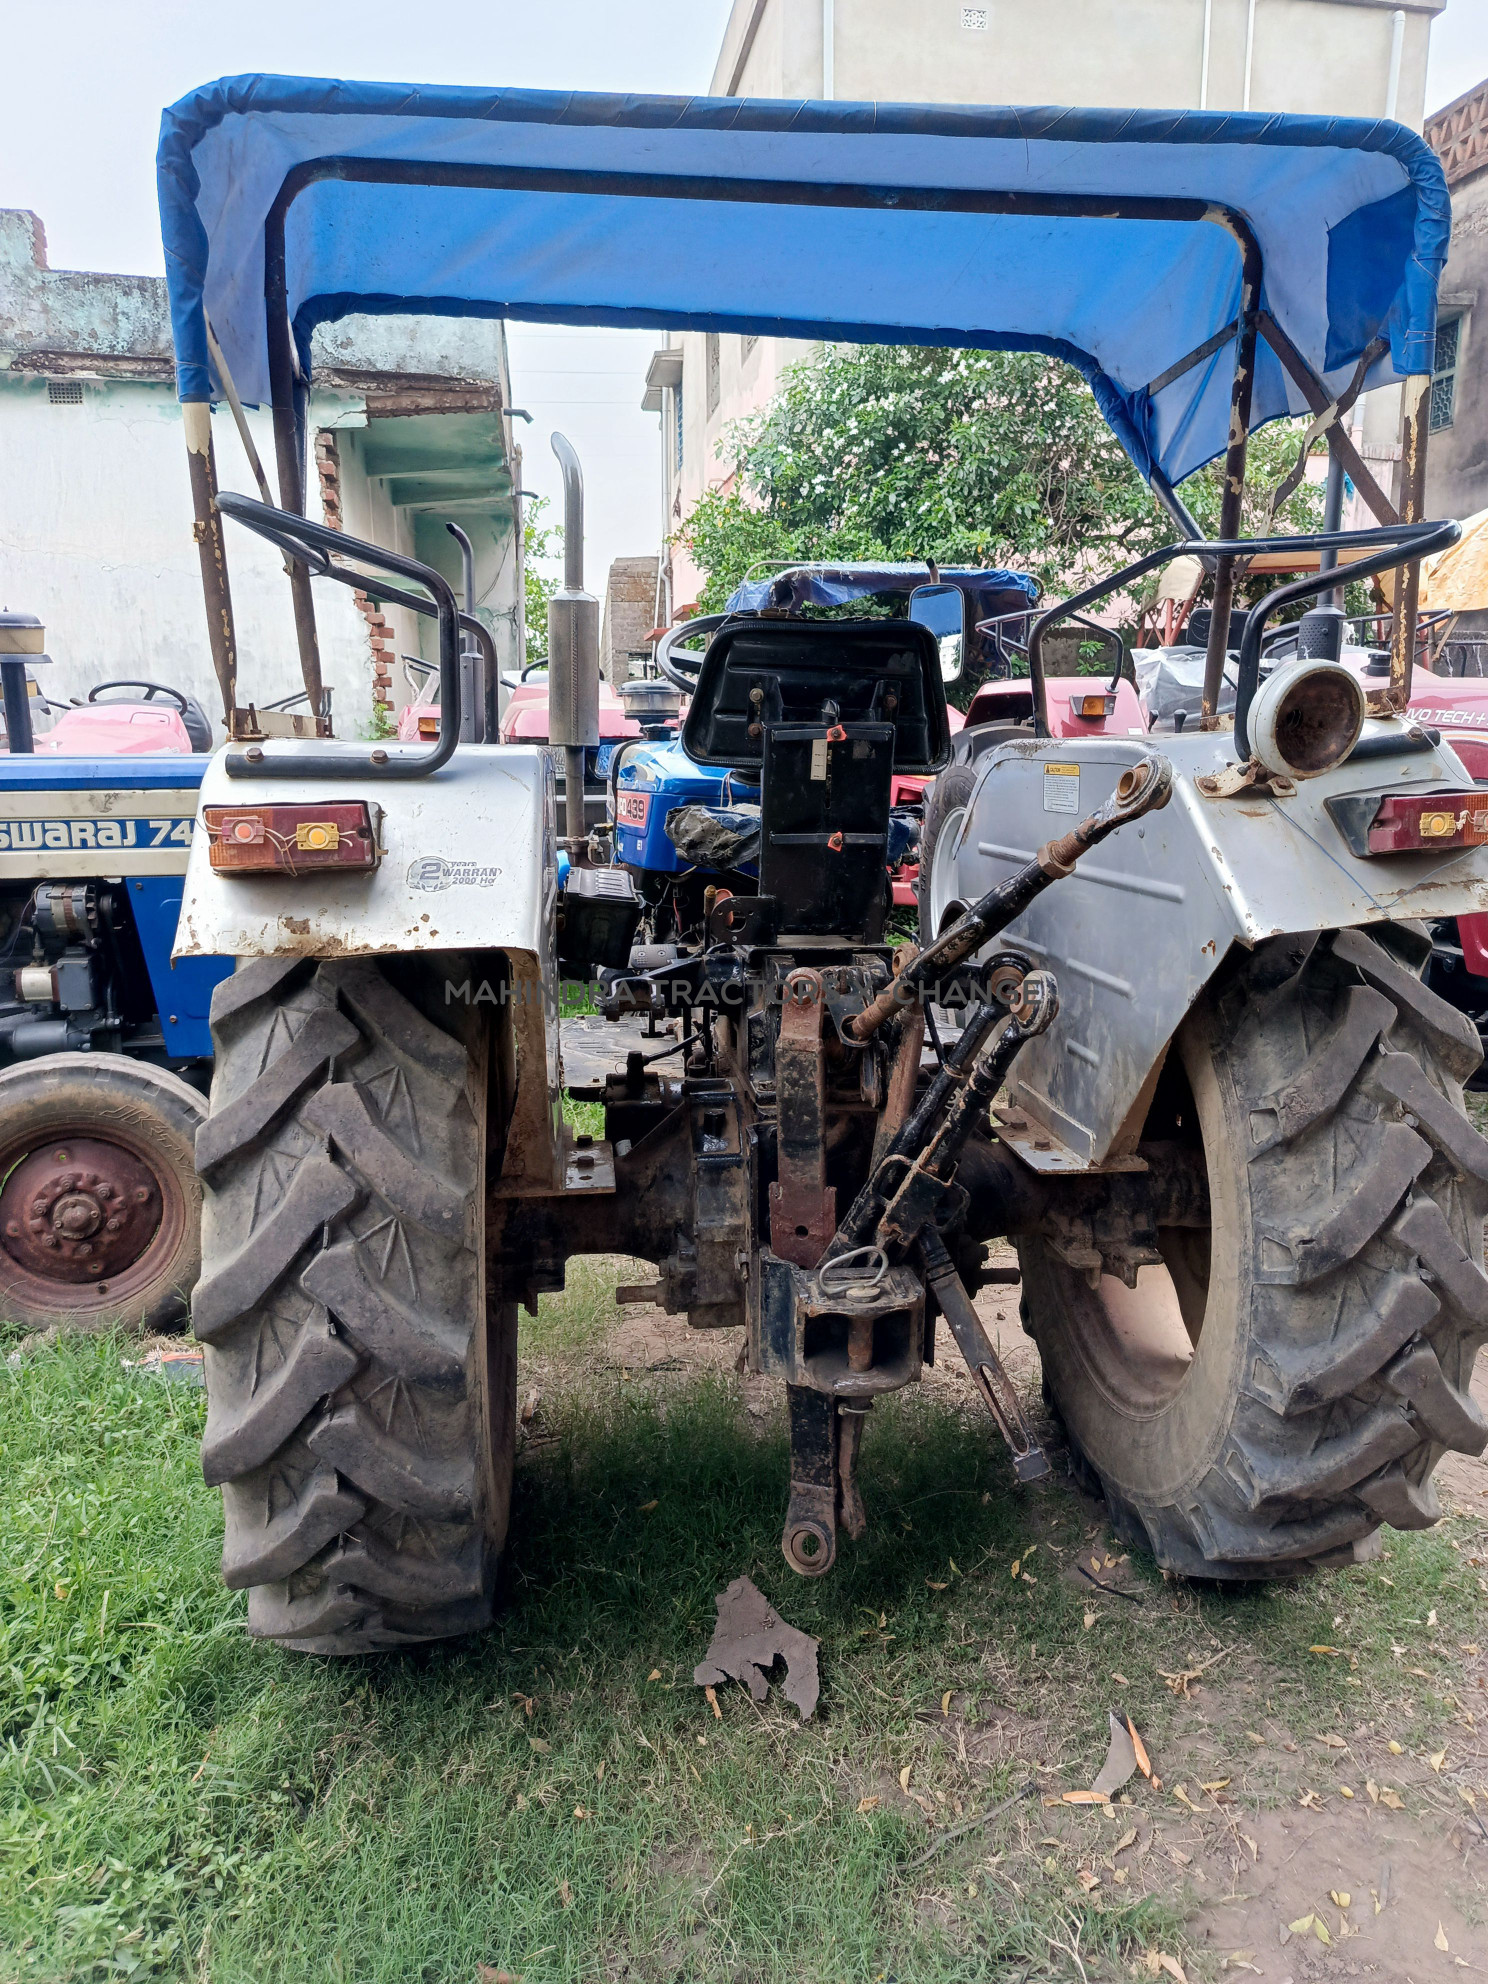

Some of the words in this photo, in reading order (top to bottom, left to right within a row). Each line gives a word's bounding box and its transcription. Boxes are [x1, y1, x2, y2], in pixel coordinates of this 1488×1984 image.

[627, 797, 645, 822] 439
[149, 820, 194, 847] 74
[420, 862, 441, 880] 2
[451, 877, 477, 885] 2000
